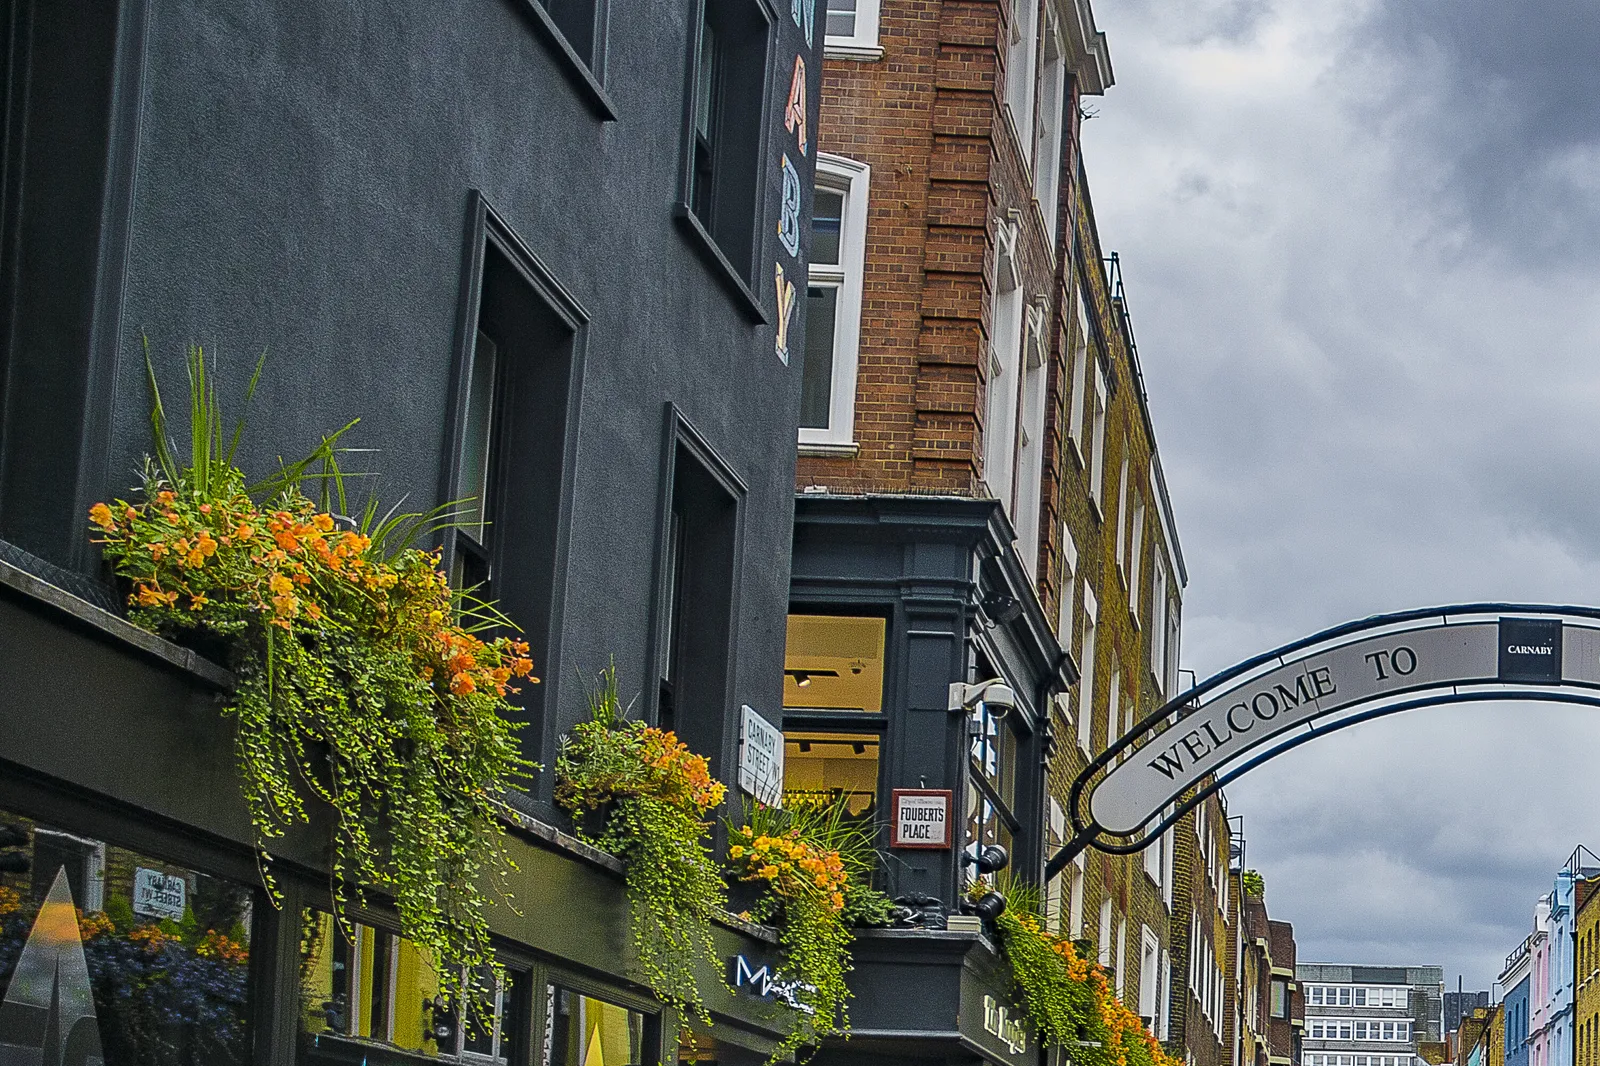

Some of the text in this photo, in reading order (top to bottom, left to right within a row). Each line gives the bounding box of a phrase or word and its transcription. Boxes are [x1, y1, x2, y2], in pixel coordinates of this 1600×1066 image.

[1508, 644, 1553, 655] CARNABY
[1147, 667, 1337, 780] WELCOME
[1365, 647, 1417, 681] TO
[748, 718, 776, 757] CARNABY
[748, 743, 770, 776] STREET
[903, 824, 930, 839] PLACE
